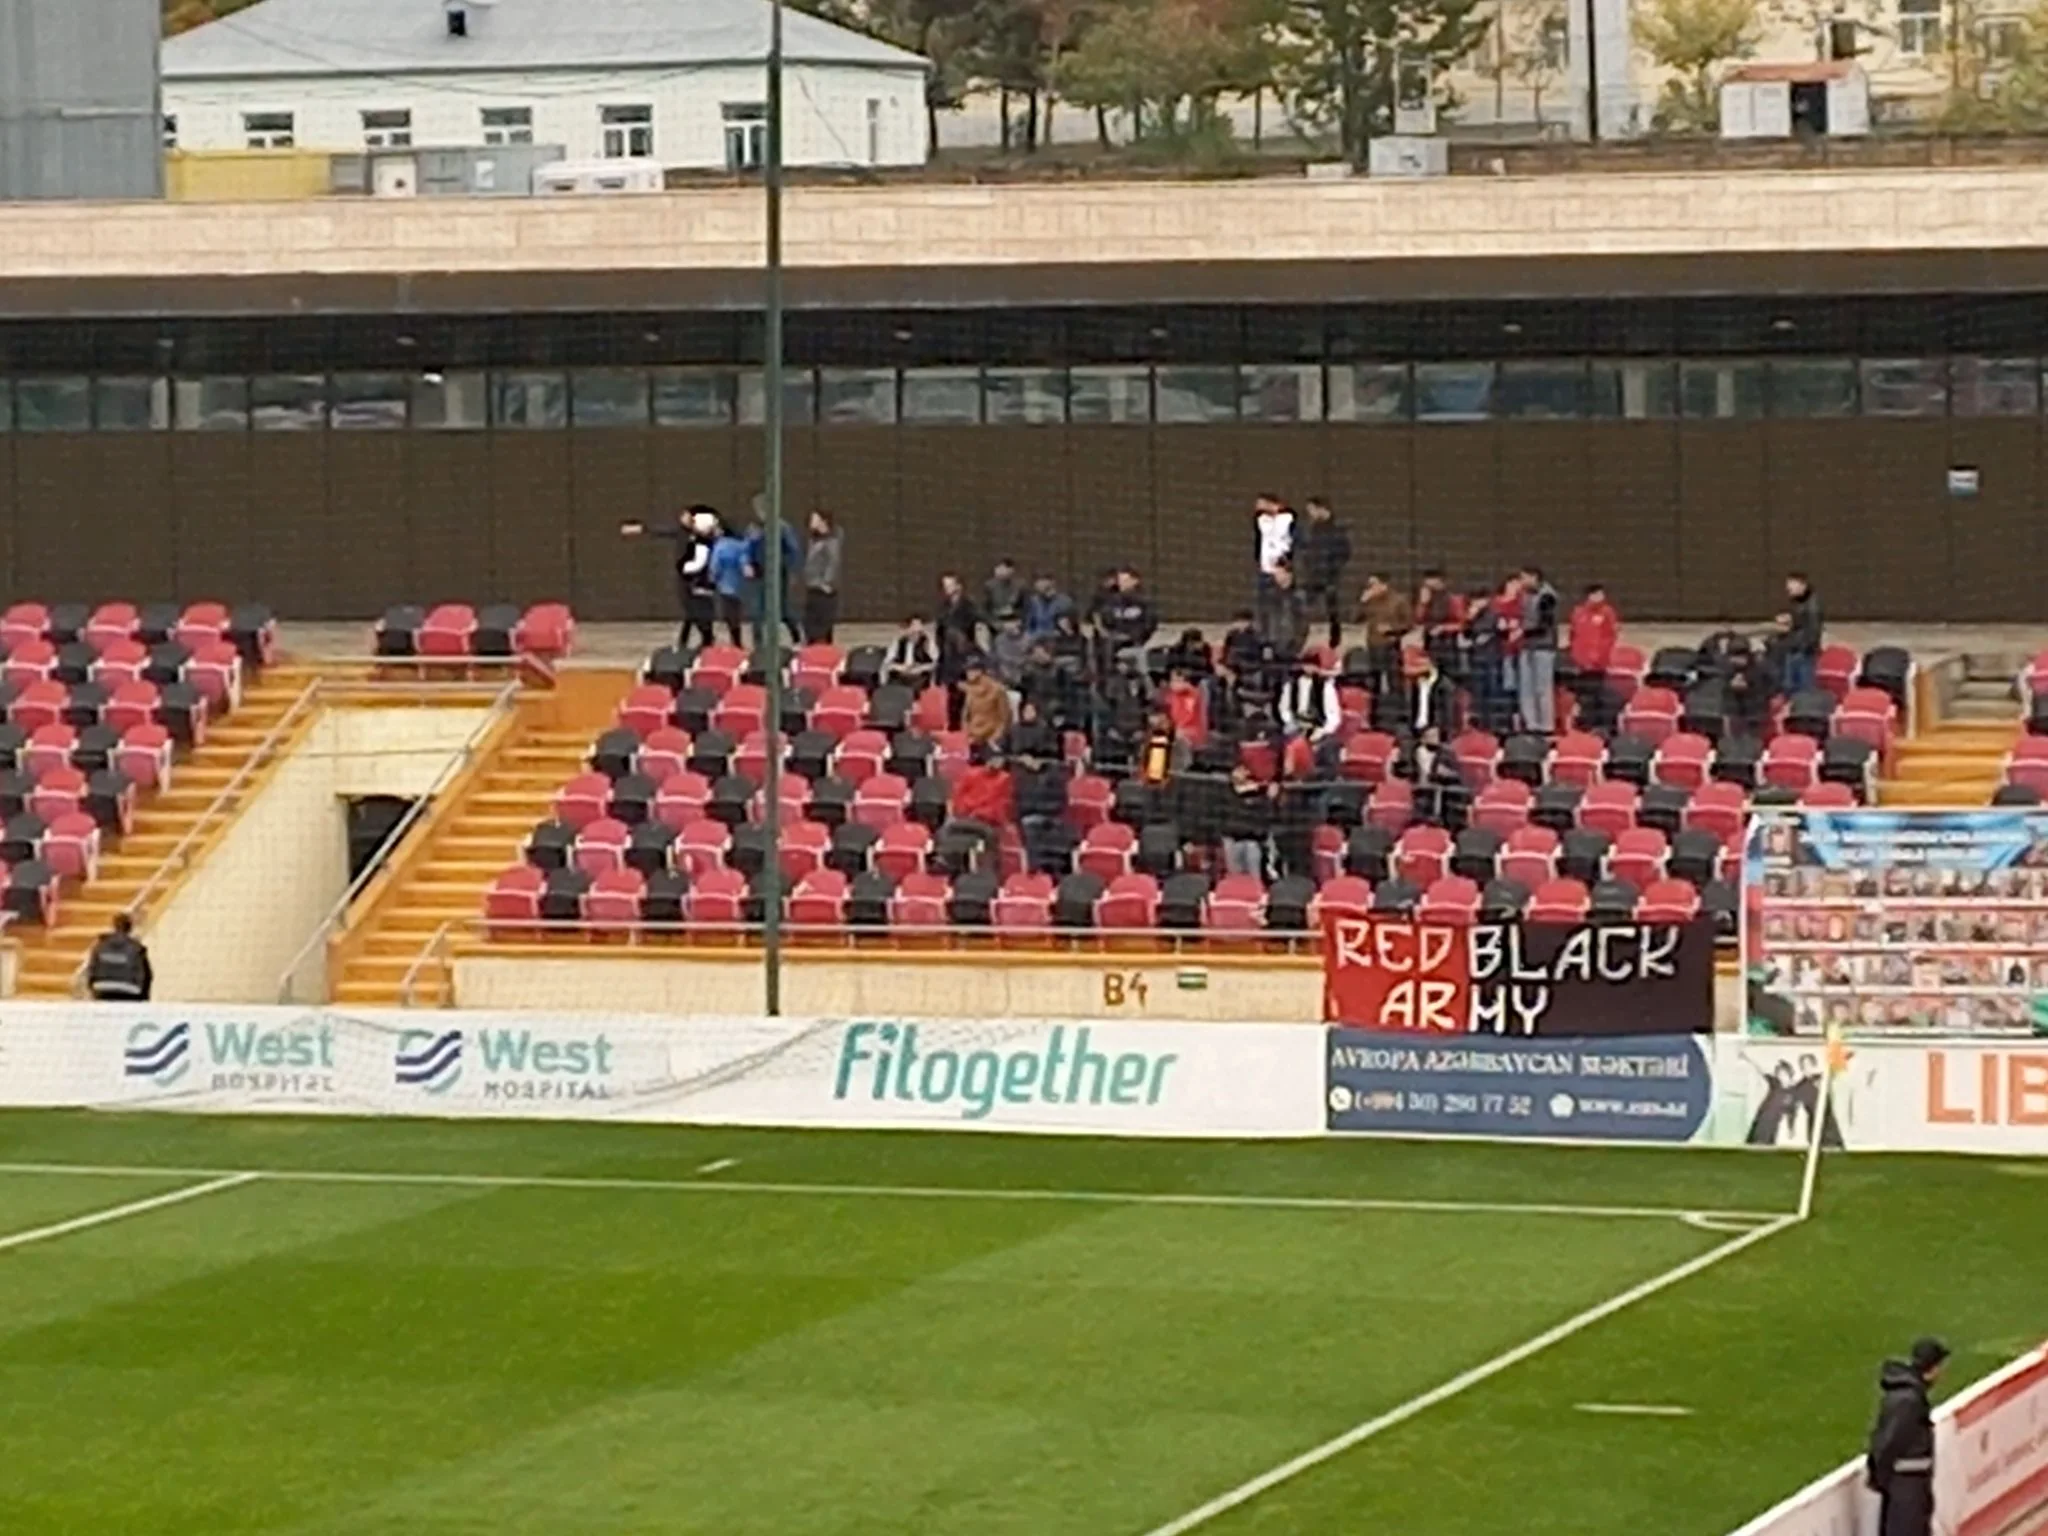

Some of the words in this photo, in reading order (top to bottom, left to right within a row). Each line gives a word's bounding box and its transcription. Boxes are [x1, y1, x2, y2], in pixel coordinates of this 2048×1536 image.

[1335, 919, 1453, 973] RED
[1468, 924, 1680, 982] BLACK
[1104, 972, 1148, 1008] B4
[1379, 980, 1551, 1035] ARMY
[205, 1021, 334, 1067] West
[478, 1028, 614, 1075] West
[834, 1022, 1178, 1120] Fitogether
[1926, 1051, 2048, 1126] LIB
